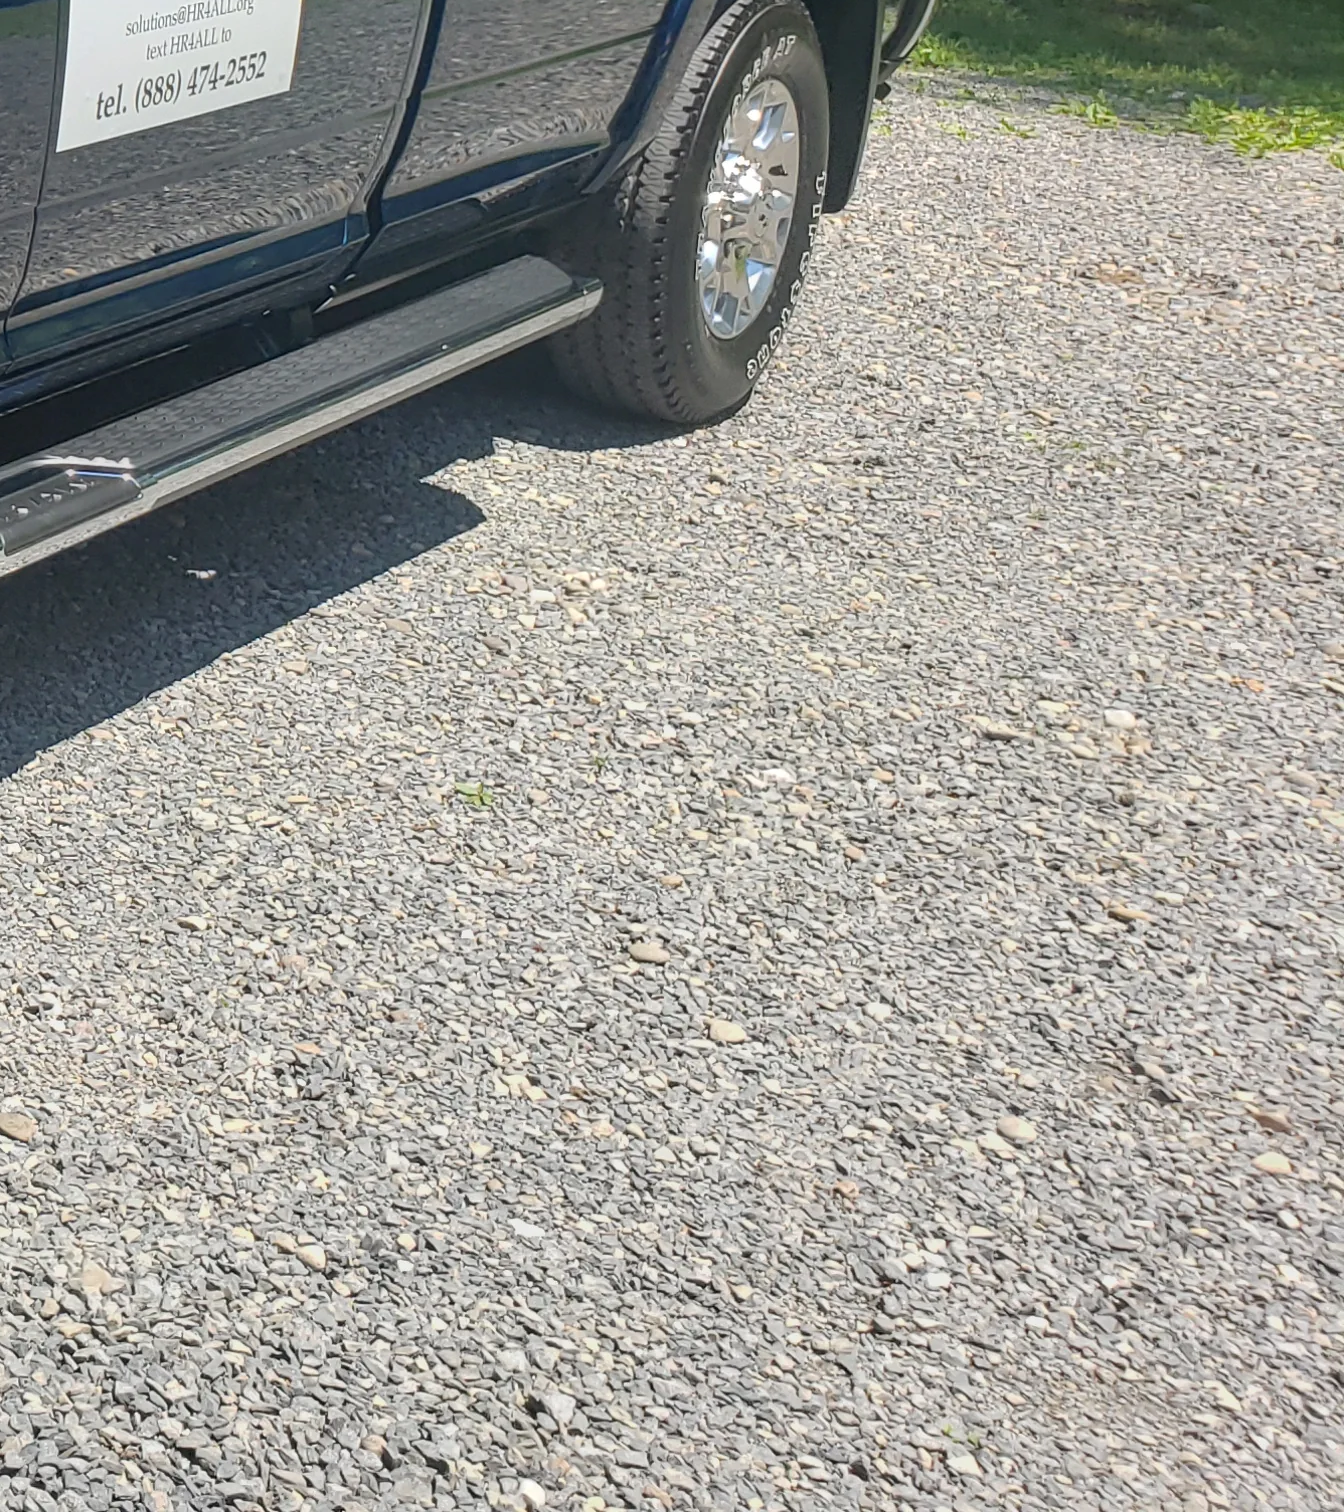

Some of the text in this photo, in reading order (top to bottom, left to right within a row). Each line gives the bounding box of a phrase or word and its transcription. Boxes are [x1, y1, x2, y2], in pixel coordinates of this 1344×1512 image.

[146, 27, 232, 60] text HR4ALL to
[96, 50, 267, 120] tel. (888) 474-2552
